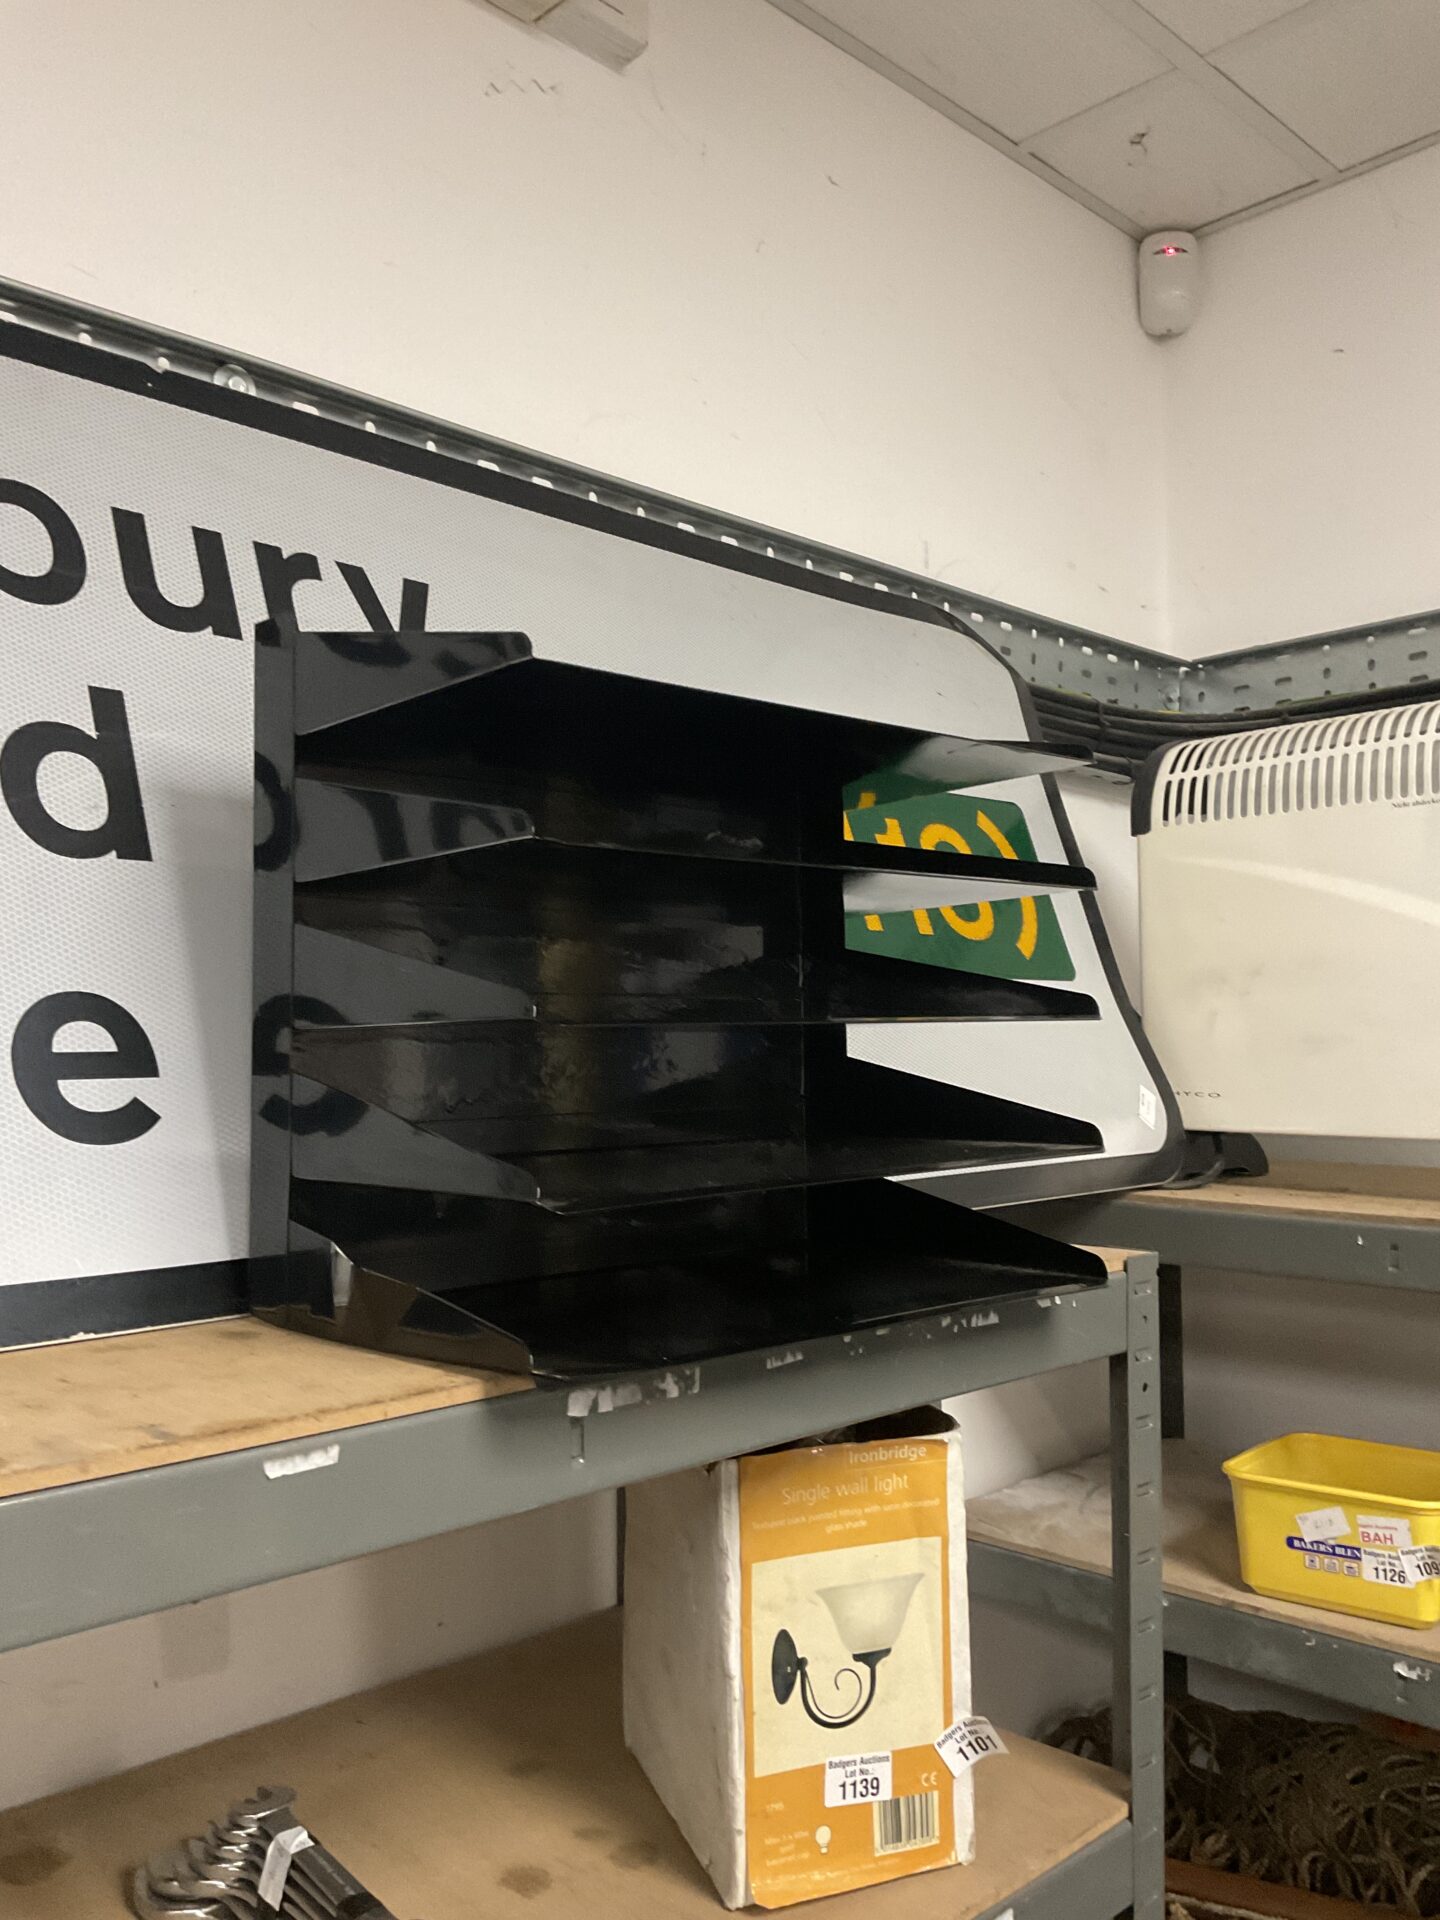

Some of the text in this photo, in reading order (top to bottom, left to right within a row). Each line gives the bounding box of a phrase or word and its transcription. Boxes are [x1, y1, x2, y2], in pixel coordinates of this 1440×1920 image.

[850, 1444, 928, 1464] Ironbridge
[782, 1472, 909, 1506] Single wall light
[1361, 1531, 1394, 1545] BAH
[1373, 1566, 1406, 1584] 1126
[1415, 1560, 1440, 1577] 109
[936, 1725, 963, 1749] Badgers
[954, 1733, 968, 1744] Lot
[957, 1734, 998, 1761] 1101
[828, 1755, 890, 1770] Badgers Auctions
[844, 1769, 857, 1778] Lot
[839, 1777, 880, 1800] 1139
